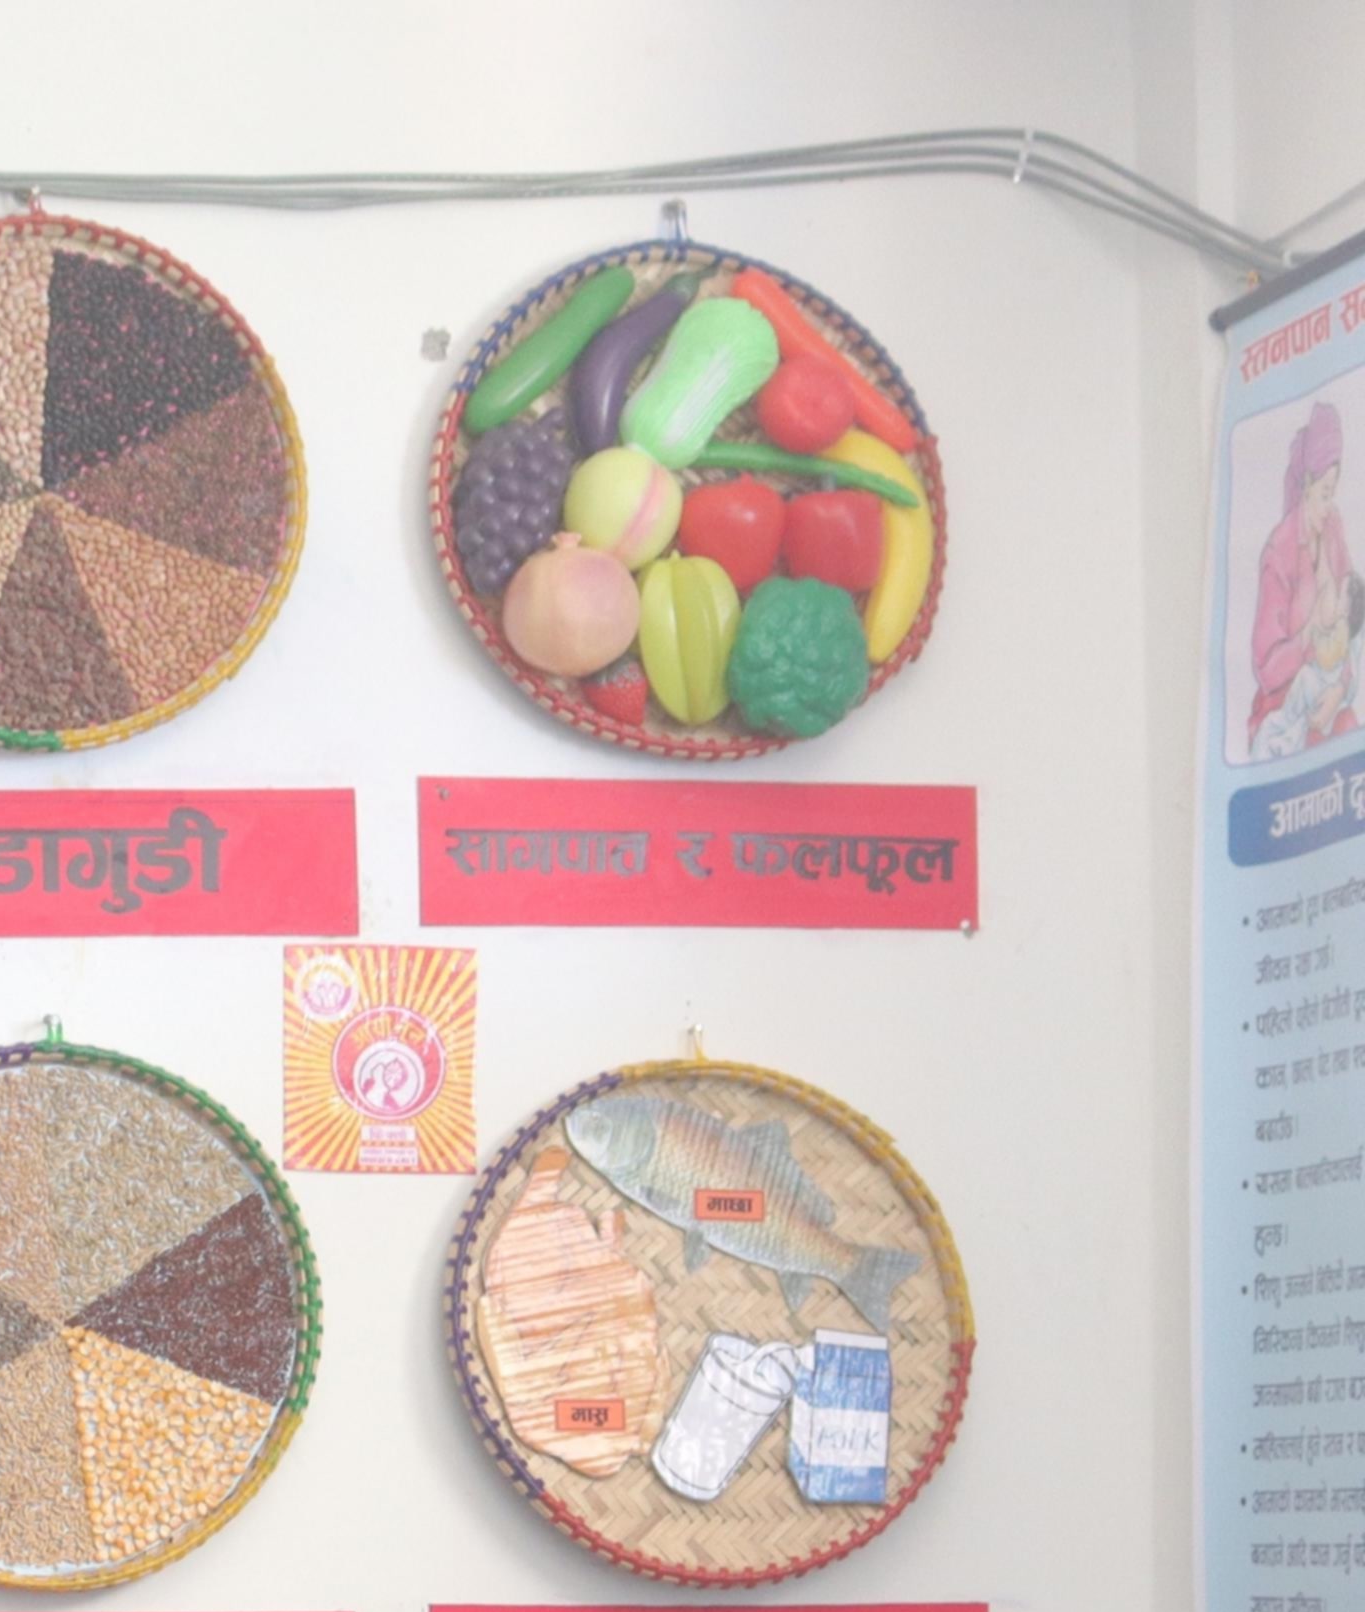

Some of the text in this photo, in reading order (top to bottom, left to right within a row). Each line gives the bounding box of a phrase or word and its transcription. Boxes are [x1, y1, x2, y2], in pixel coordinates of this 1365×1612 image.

[444, 827, 961, 897] सागपात र फलफूल
[570, 1405, 610, 1424] मासु
